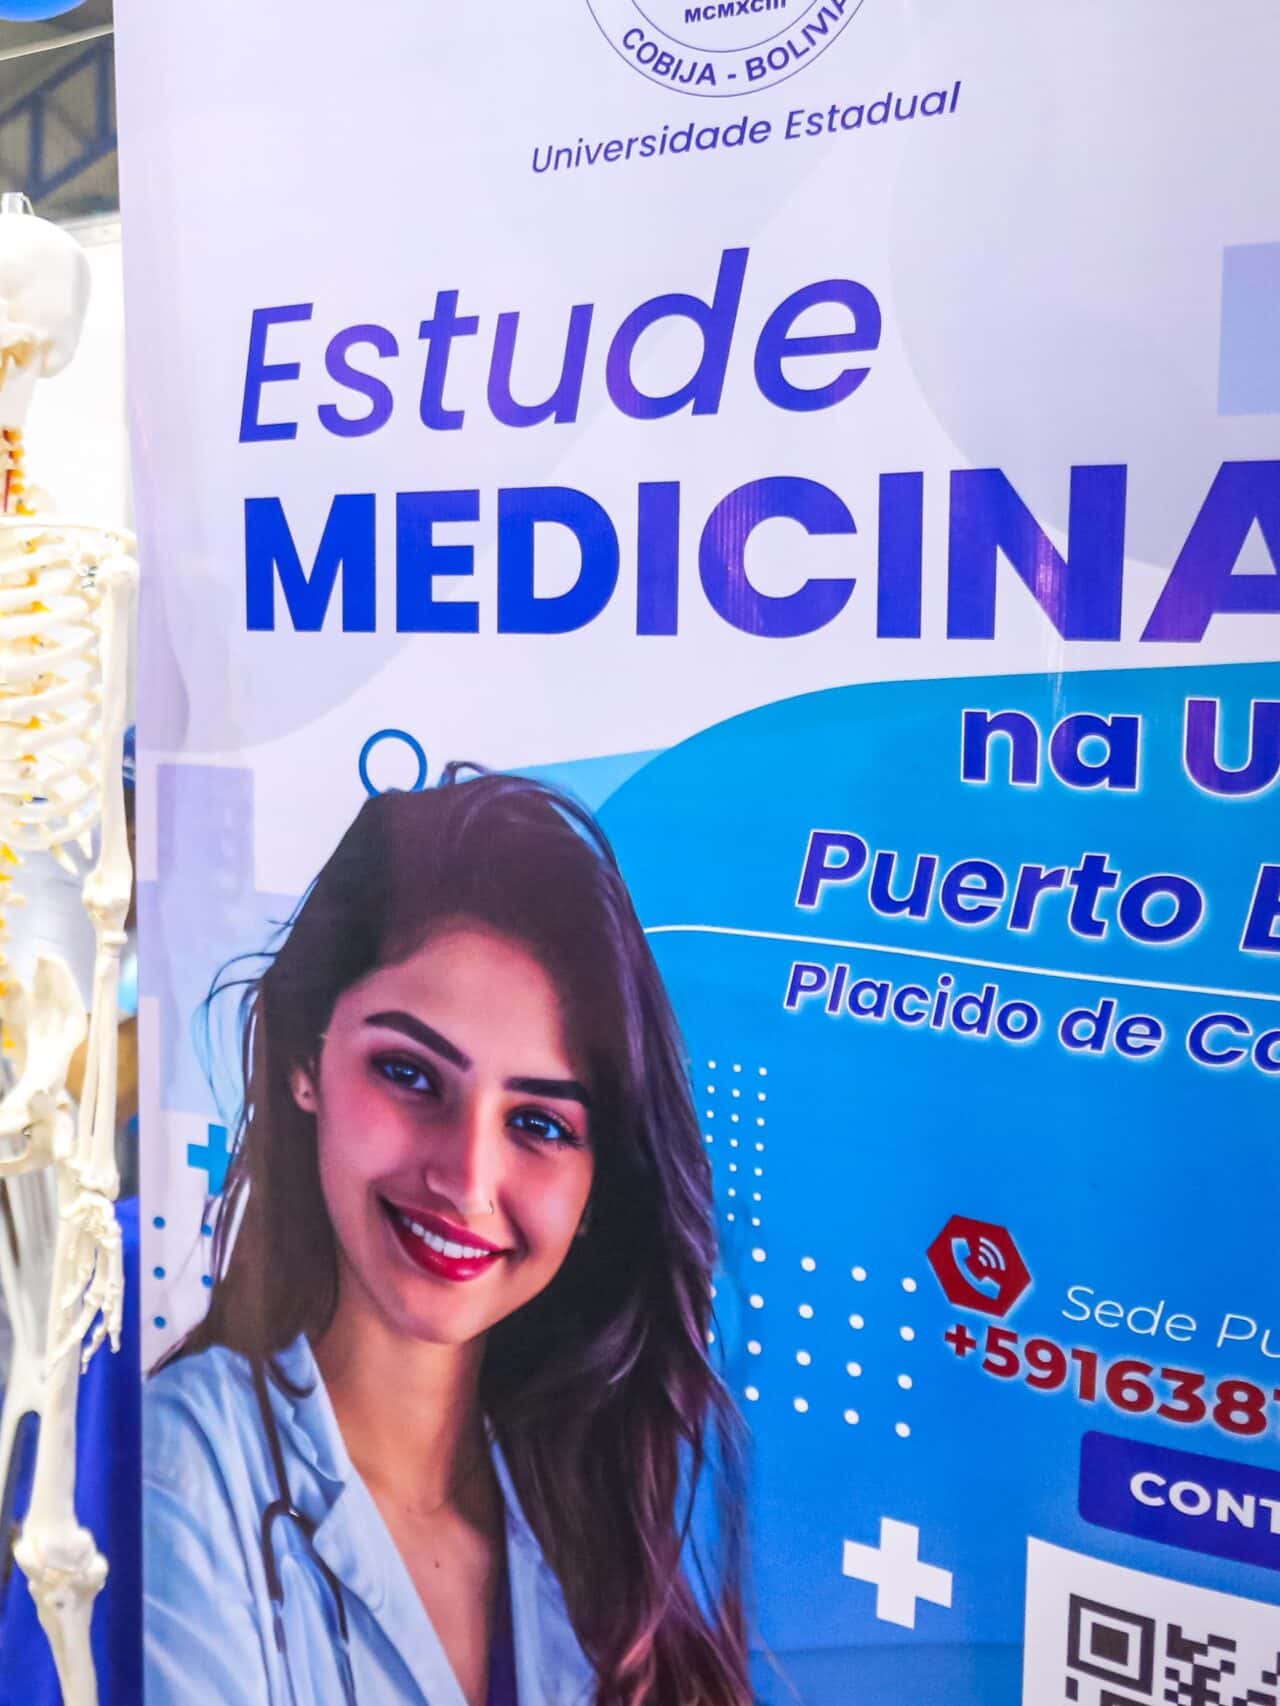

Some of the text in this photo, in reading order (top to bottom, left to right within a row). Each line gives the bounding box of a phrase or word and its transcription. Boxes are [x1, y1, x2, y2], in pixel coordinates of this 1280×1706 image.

[621, 27, 718, 86] COBIJA
[744, 0, 848, 82] BOLIVIA
[530, 81, 962, 174] Universidade Estadual
[239, 247, 882, 443] Estude
[244, 460, 1280, 643] MEDICINA
[961, 707, 1142, 791] na
[795, 829, 1205, 945] Puerto
[784, 960, 1040, 1042] Placido
[1058, 997, 1164, 1058] de
[1061, 1284, 1198, 1343] Sede
[944, 1322, 1280, 1437] +591638
[1129, 1471, 1280, 1536] CONT
